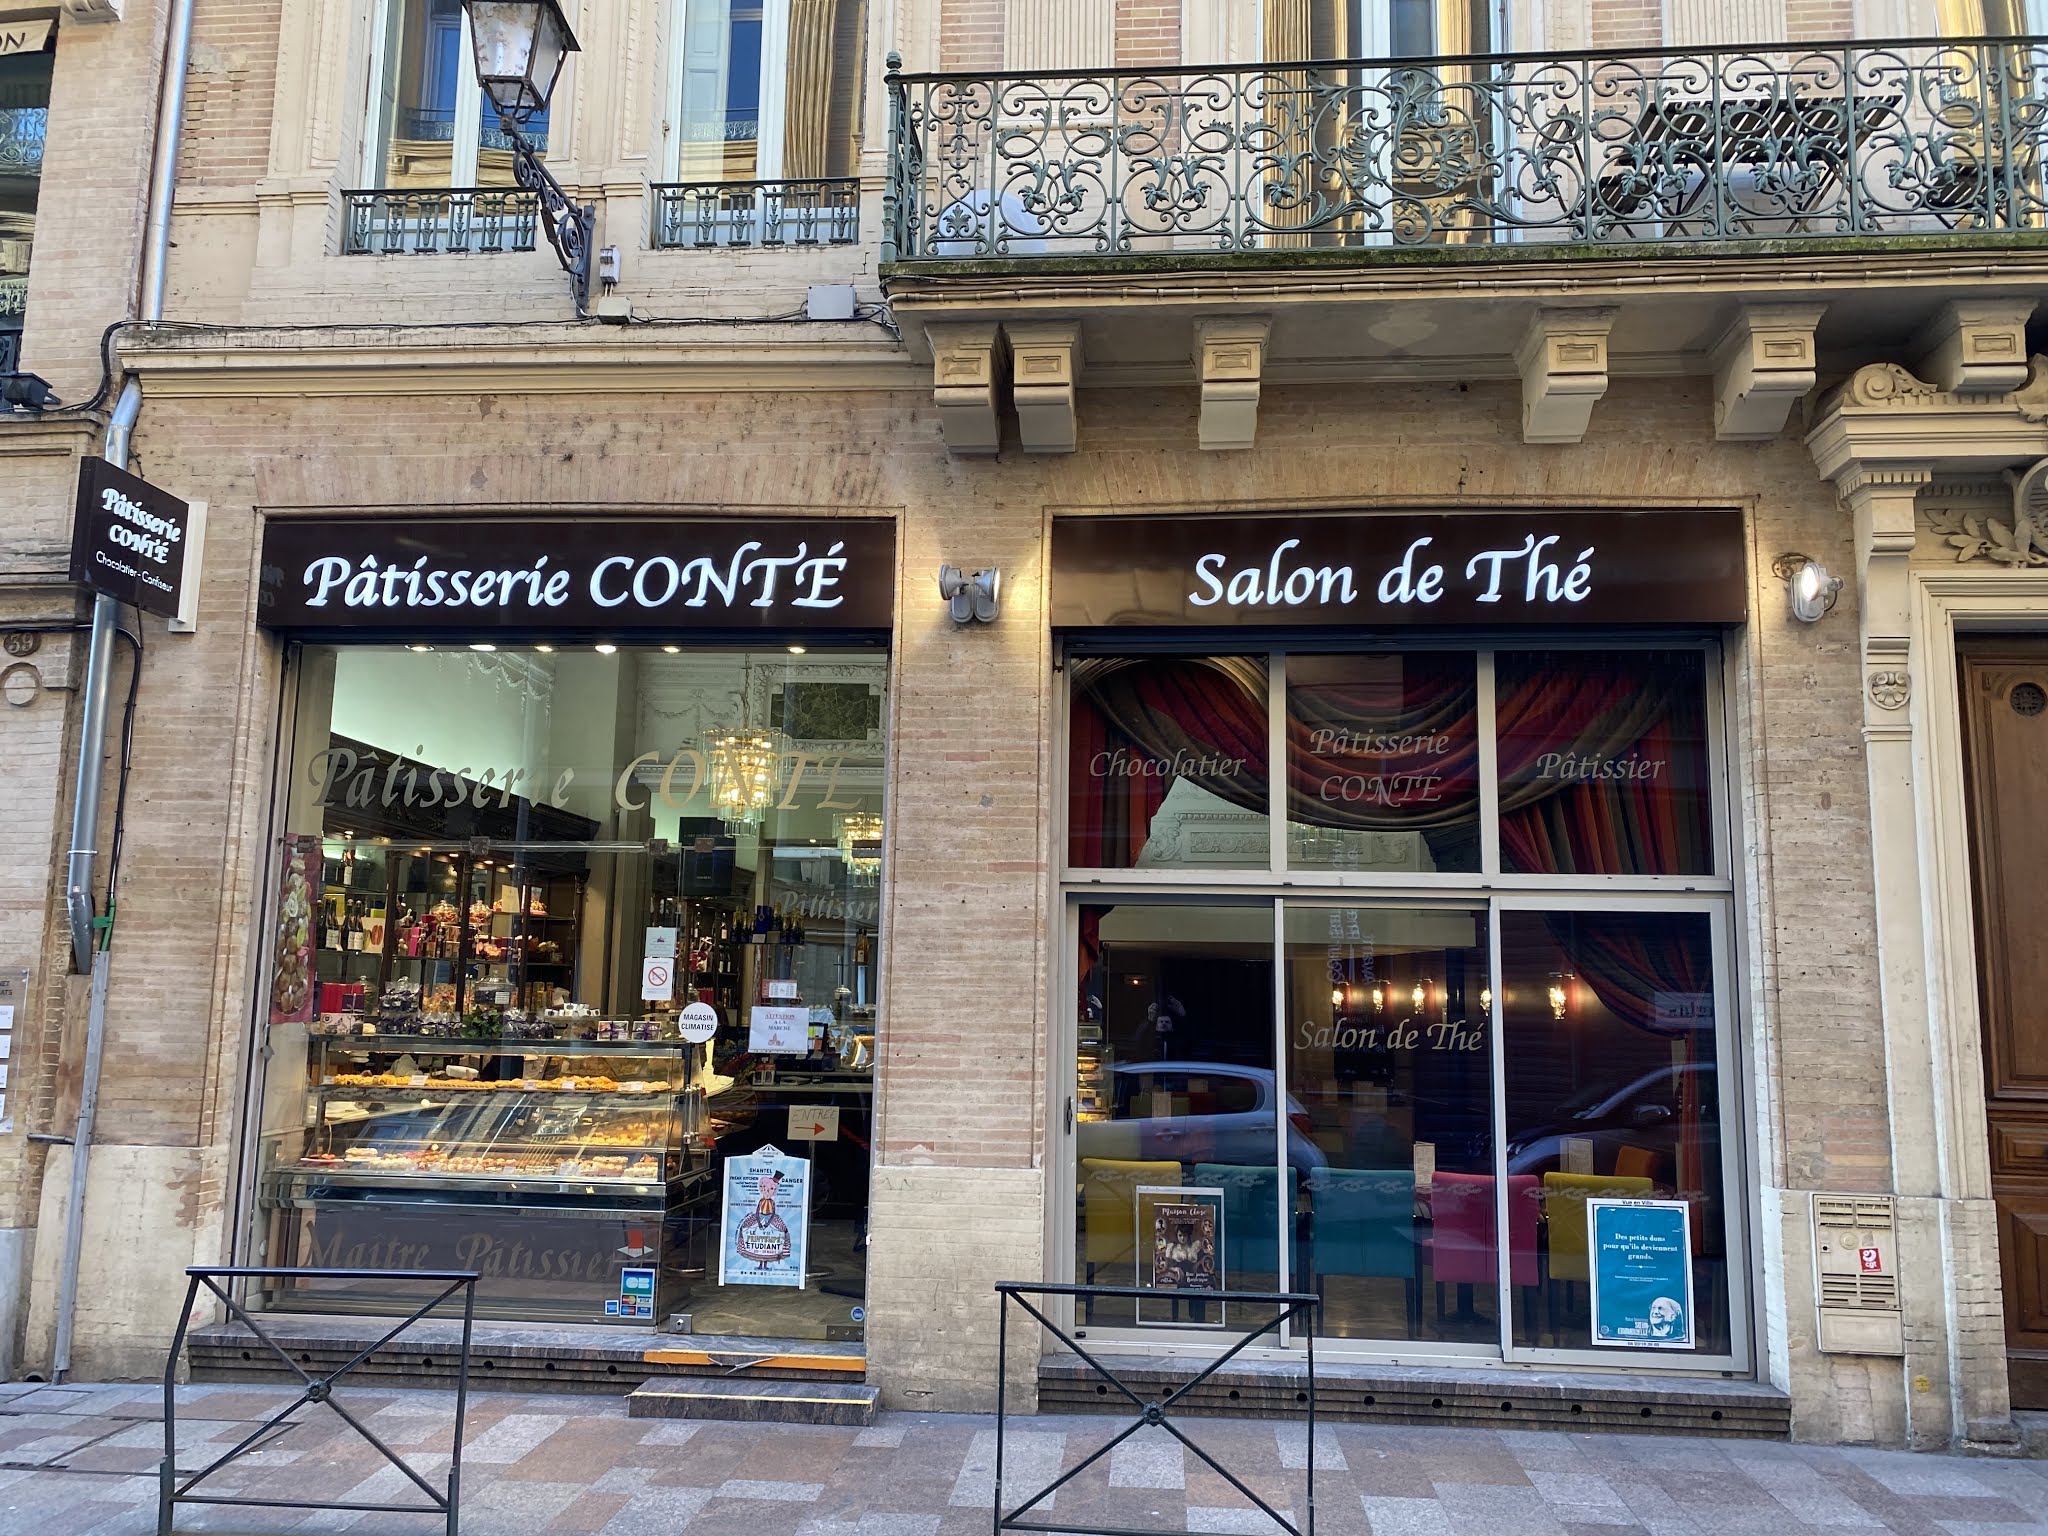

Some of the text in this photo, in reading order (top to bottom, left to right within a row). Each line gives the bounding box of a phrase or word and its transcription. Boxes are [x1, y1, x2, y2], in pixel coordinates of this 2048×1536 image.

[101, 488, 181, 542] Pâtisserie
[109, 524, 169, 564] CONTÉ
[96, 550, 137, 577] Chocolatier
[141, 570, 173, 593] Confiseur
[303, 554, 570, 608] Pâtisserie
[589, 540, 848, 609] CONTÉ
[1188, 533, 1595, 606] Salon de Thé
[9, 632, 35, 654] 39
[1309, 727, 1450, 755] Pâtisserie
[307, 744, 575, 809] Pâtisserie
[1089, 747, 1247, 777] Chocolatier
[1536, 751, 1666, 779] Pâtissier
[1320, 767, 1442, 807] CONTÉ
[681, 1023, 714, 1031] CLIMATISE
[683, 1013, 714, 1022] MAGASIN
[1294, 1017, 1376, 1049] Salon
[1387, 1018, 1419, 1049] de
[1427, 1019, 1484, 1051] Thé
[1603, 1243, 1619, 1251] pour
[1640, 1244, 1678, 1252] deviennent
[1615, 1232, 1666, 1242] Des petits dons
